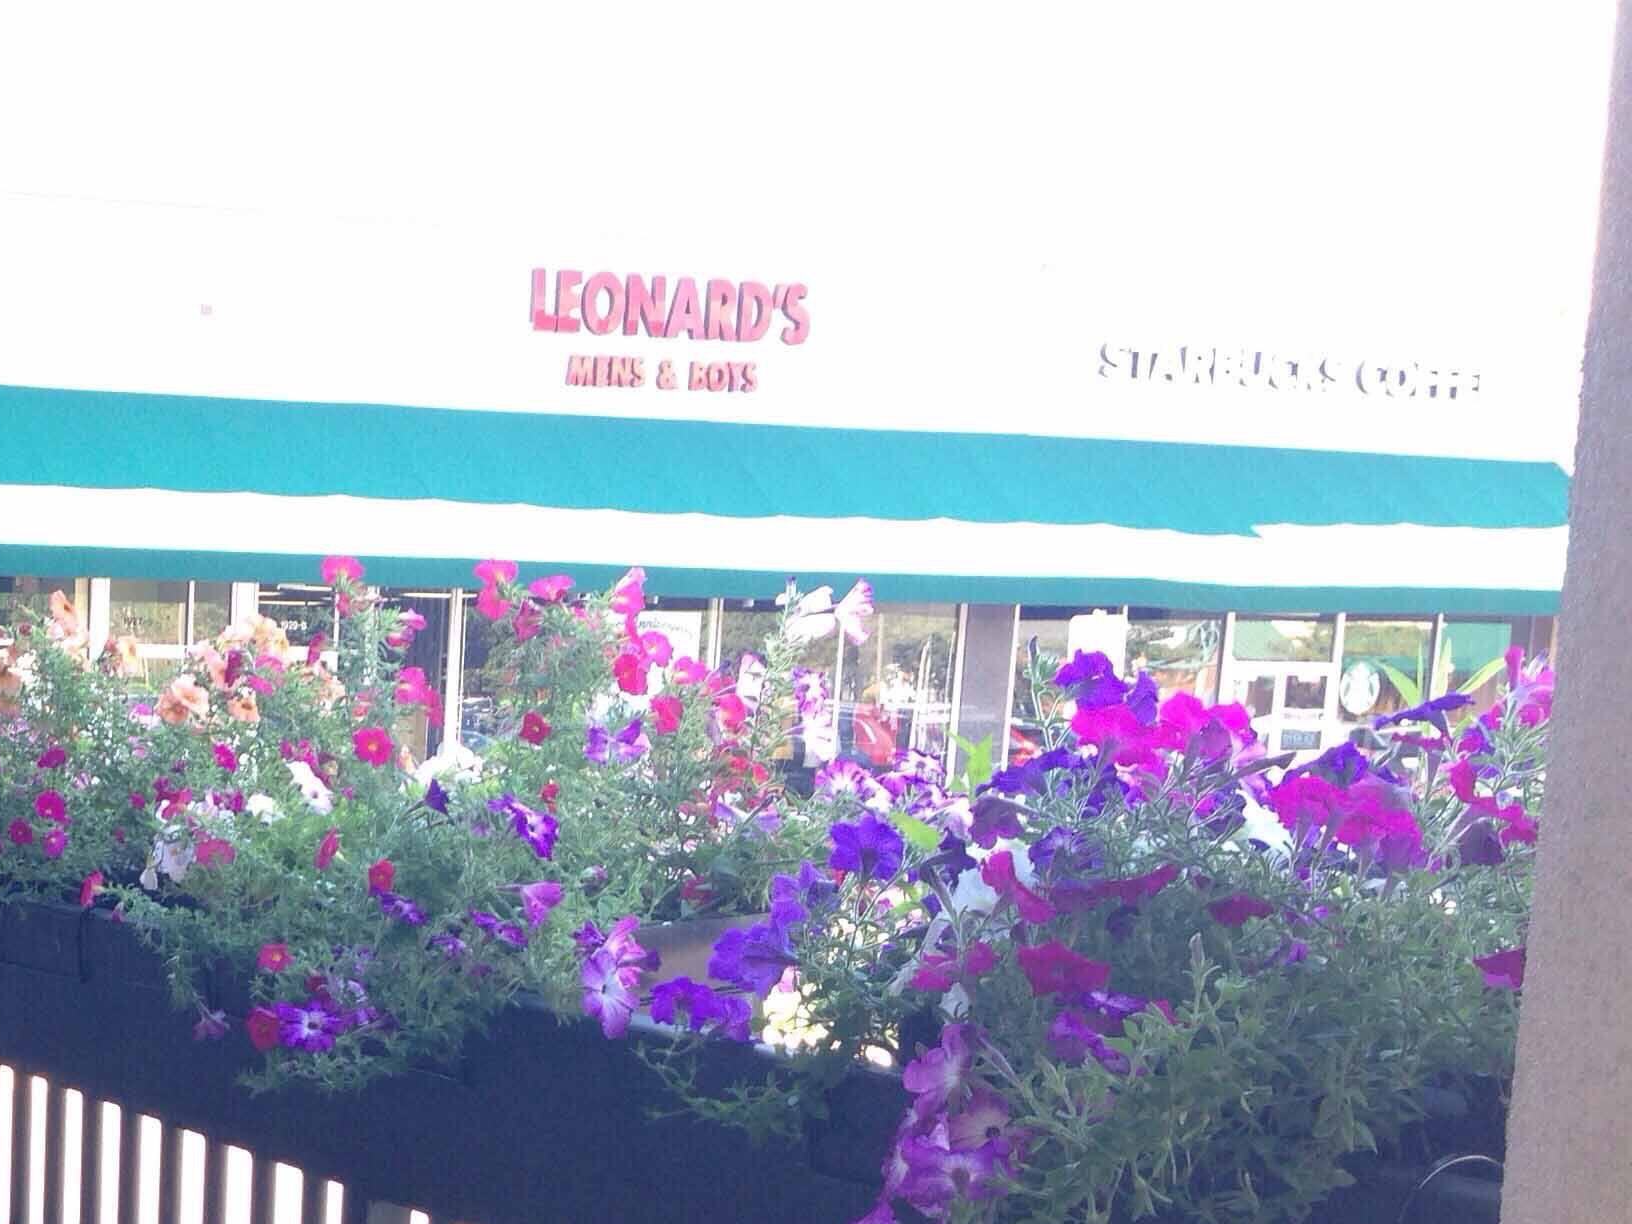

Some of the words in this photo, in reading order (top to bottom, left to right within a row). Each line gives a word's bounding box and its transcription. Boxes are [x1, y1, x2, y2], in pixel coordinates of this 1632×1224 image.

[528, 267, 810, 346] LEONARD'S
[564, 354, 646, 388] MENS
[655, 359, 678, 390] &
[687, 360, 758, 393] BOYS
